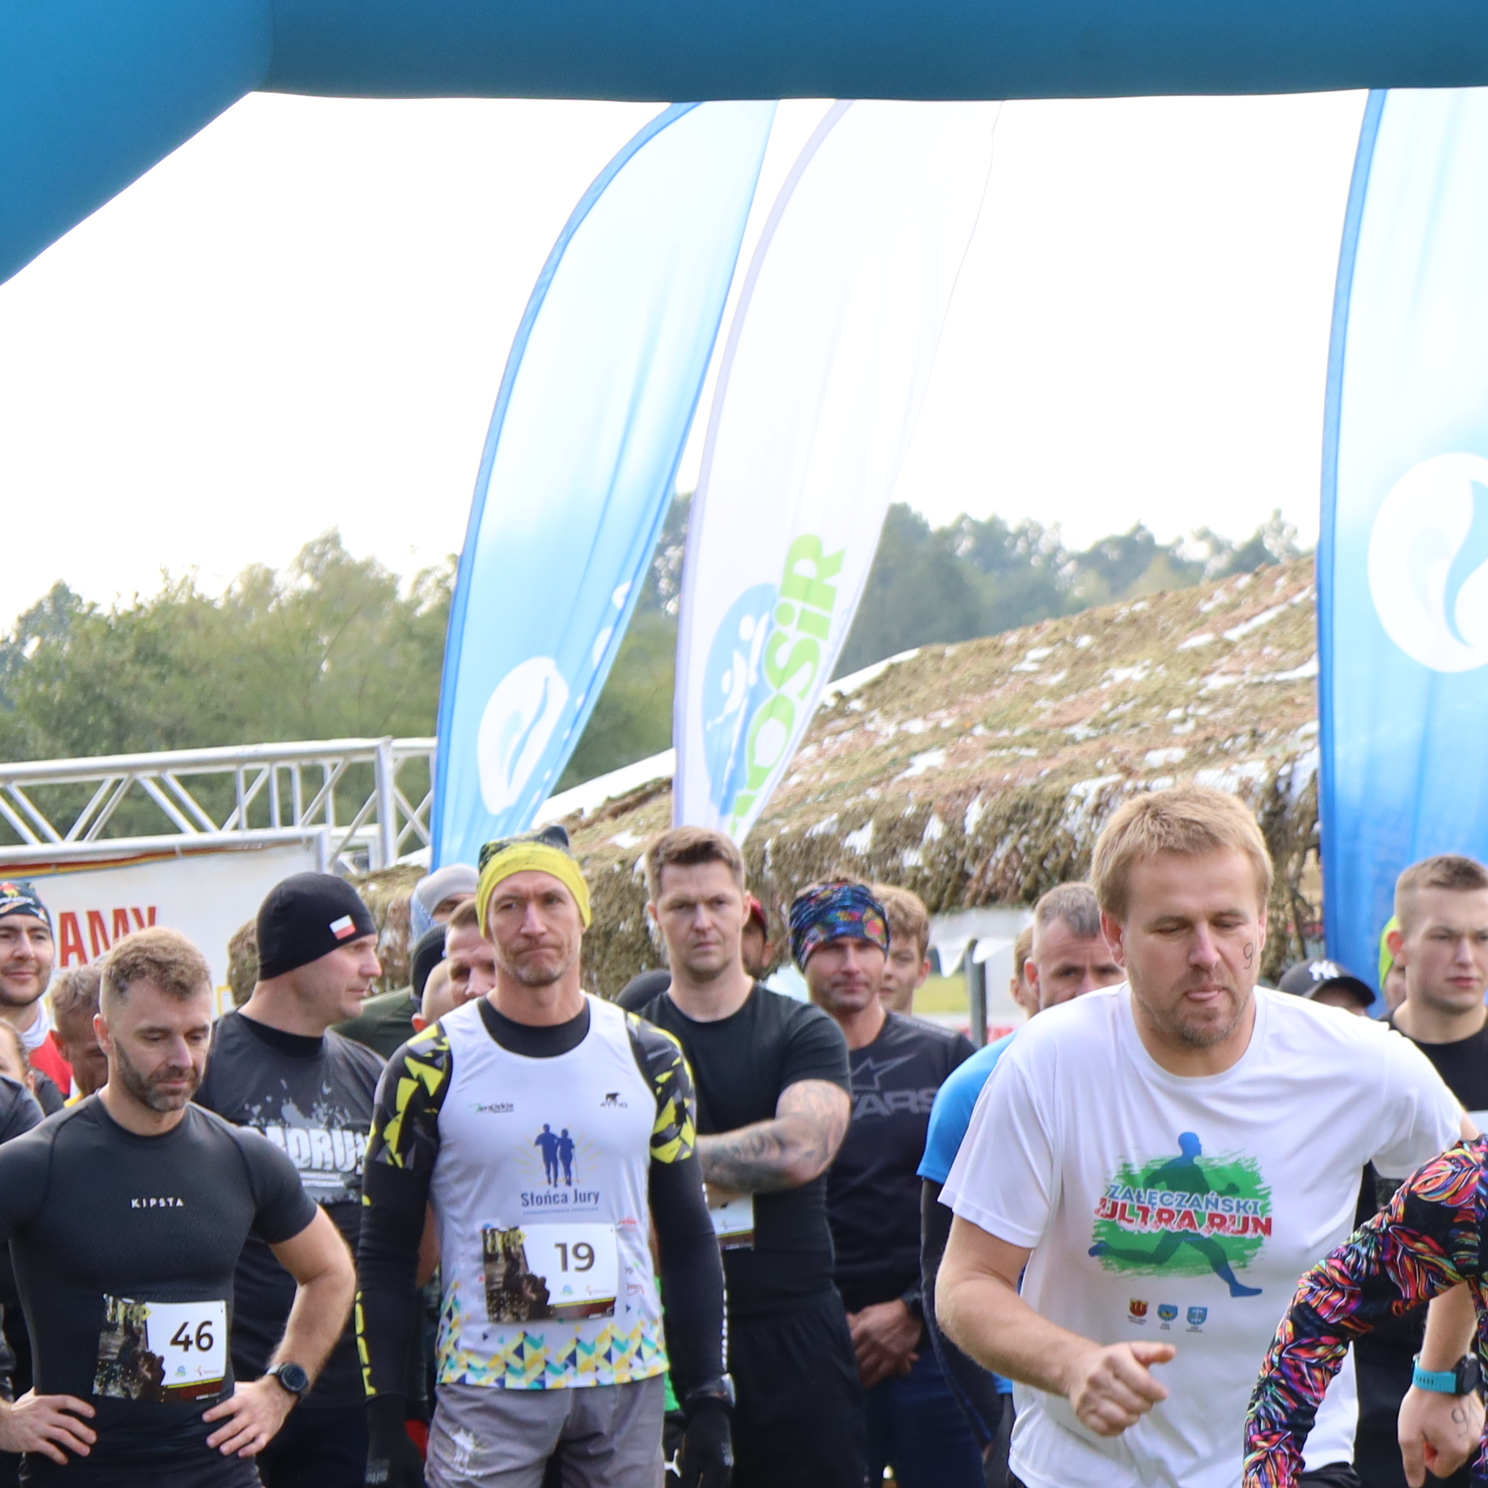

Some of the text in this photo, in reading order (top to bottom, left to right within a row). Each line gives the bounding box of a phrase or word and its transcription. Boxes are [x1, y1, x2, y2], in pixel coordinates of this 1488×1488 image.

[851, 1087, 939, 1120] ARS
[131, 1197, 184, 1208] KIPSTA
[573, 1188, 600, 1205] Jury
[1107, 1184, 1262, 1215] ZAŁĘCZAŃSKI
[1094, 1197, 1272, 1237] ULTRA RUN
[554, 1242, 595, 1272] 19
[169, 1320, 214, 1353] 46
